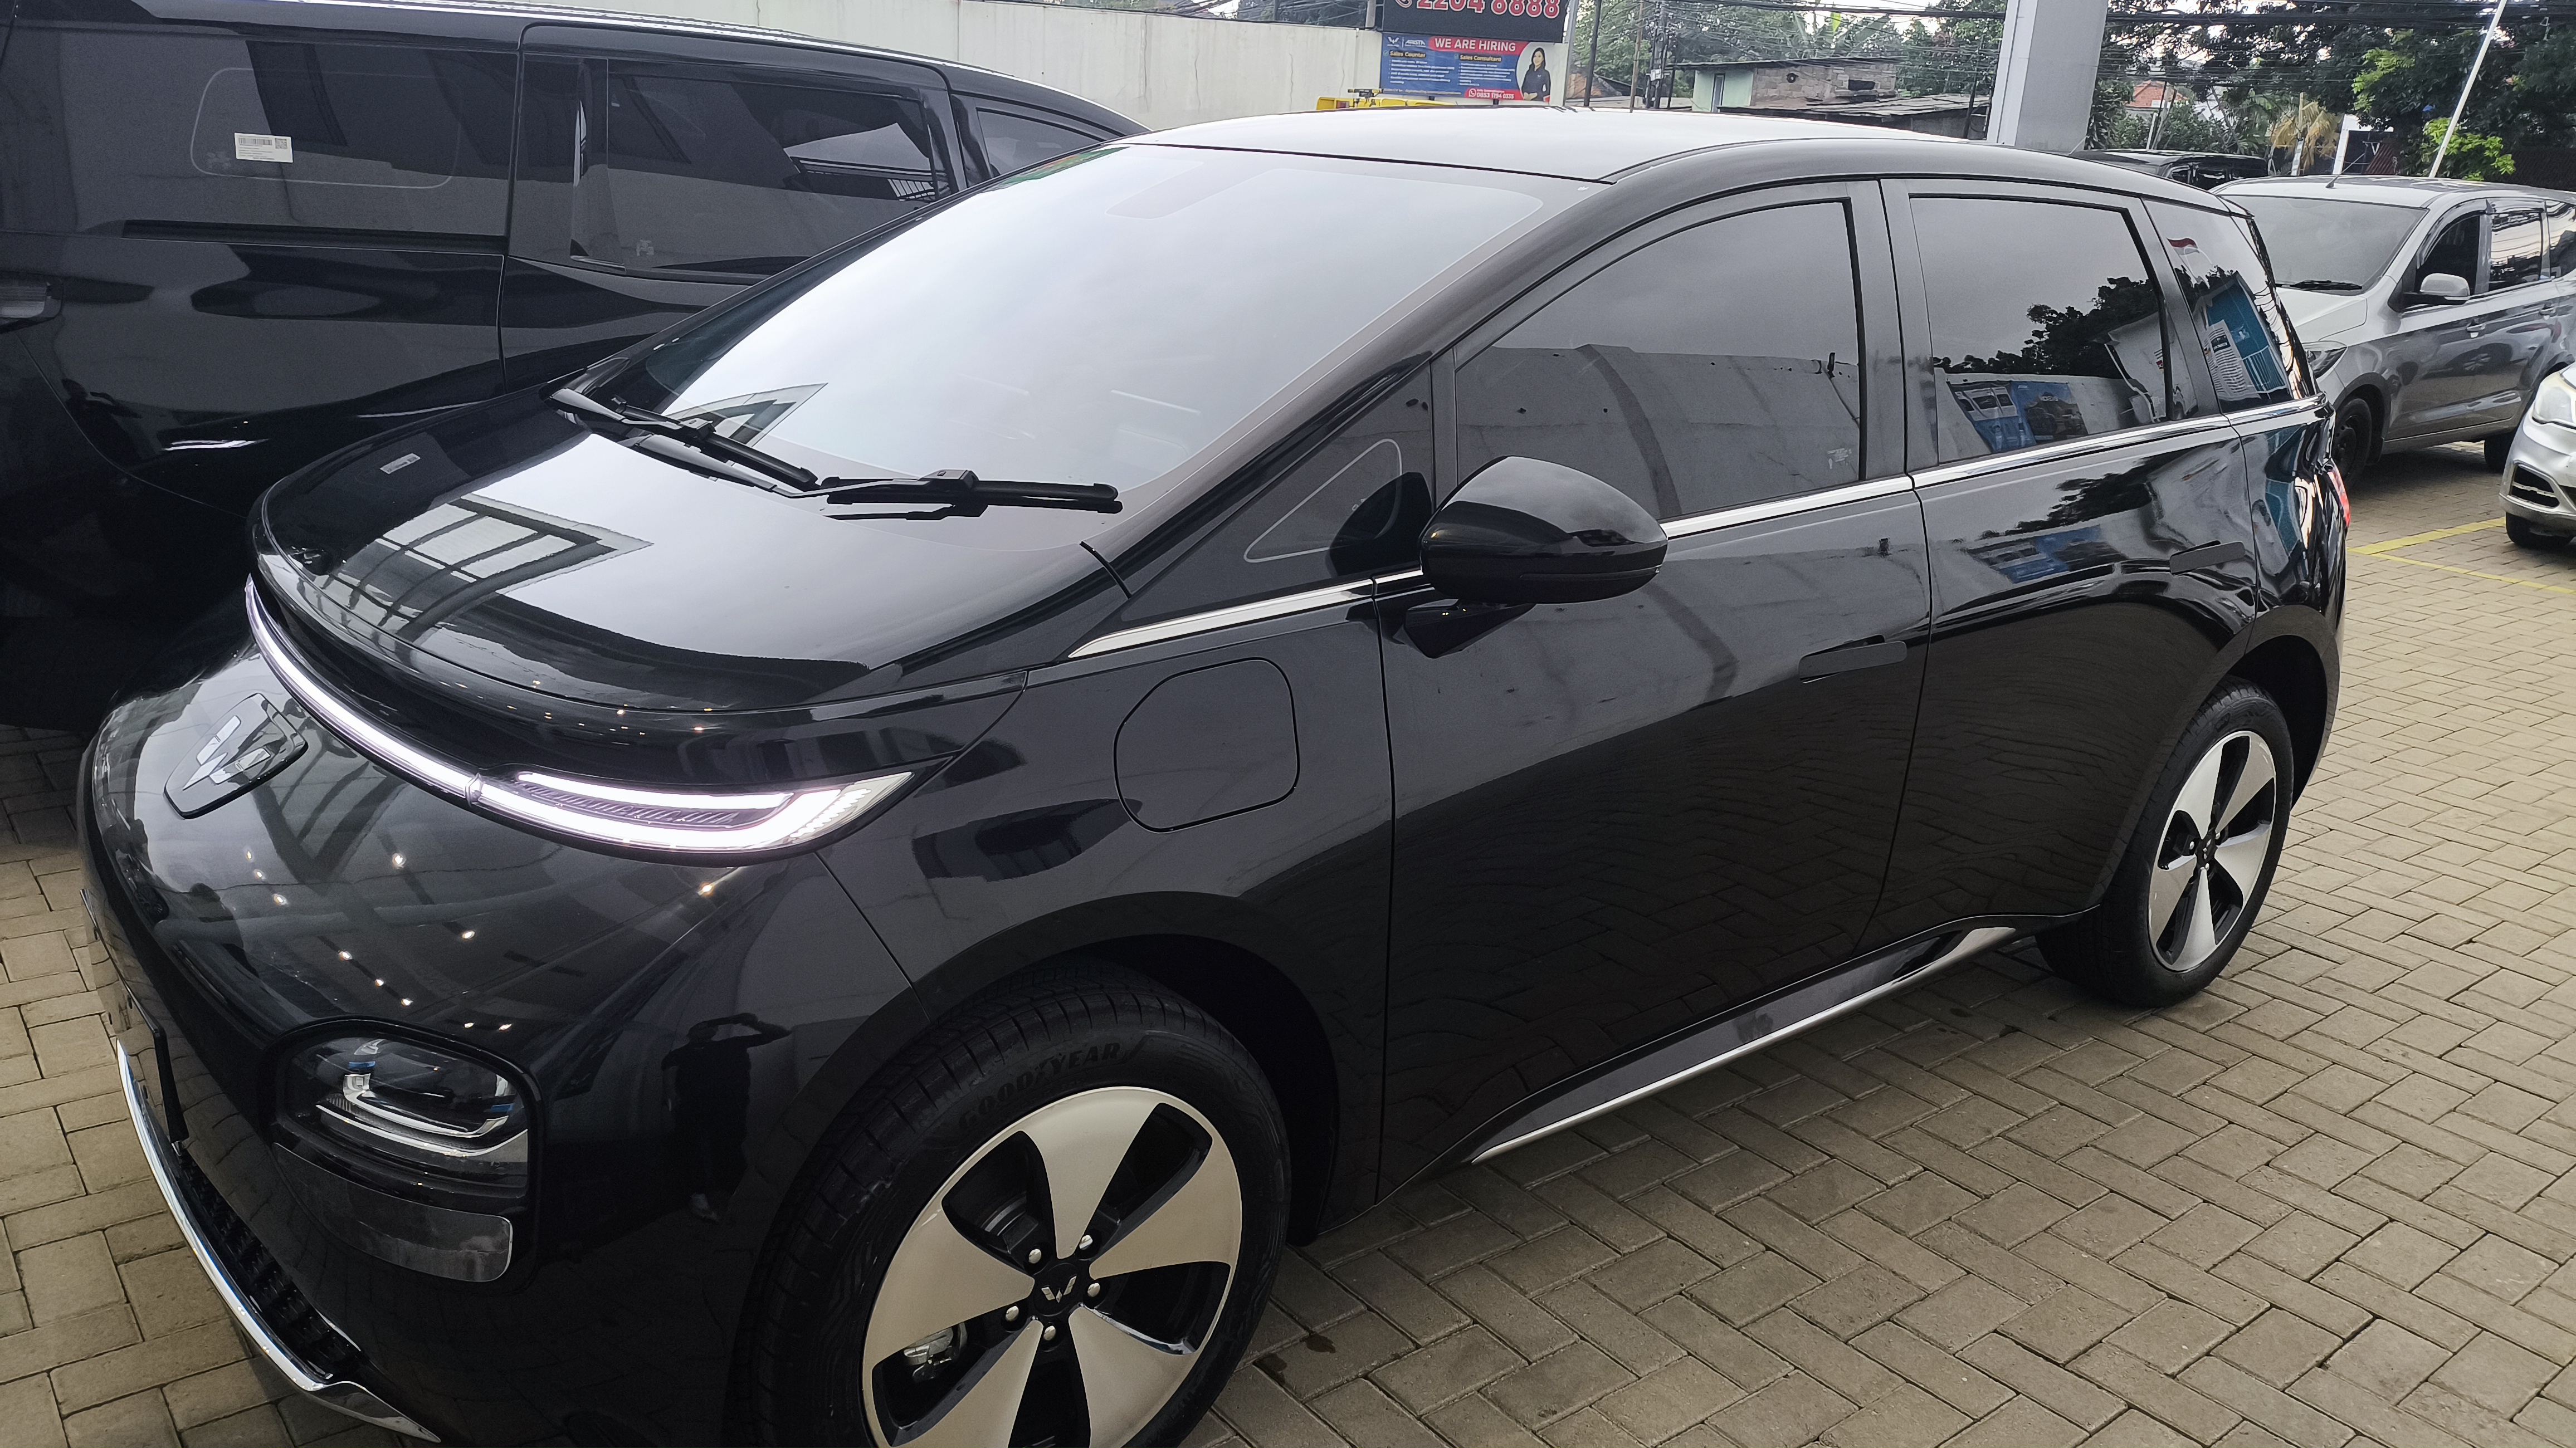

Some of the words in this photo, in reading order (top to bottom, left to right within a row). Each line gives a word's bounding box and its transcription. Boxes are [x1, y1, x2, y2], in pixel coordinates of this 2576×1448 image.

[1435, 38, 1452, 48] WE
[1454, 39, 1476, 50] ARE
[1479, 40, 1516, 52] HIRING
